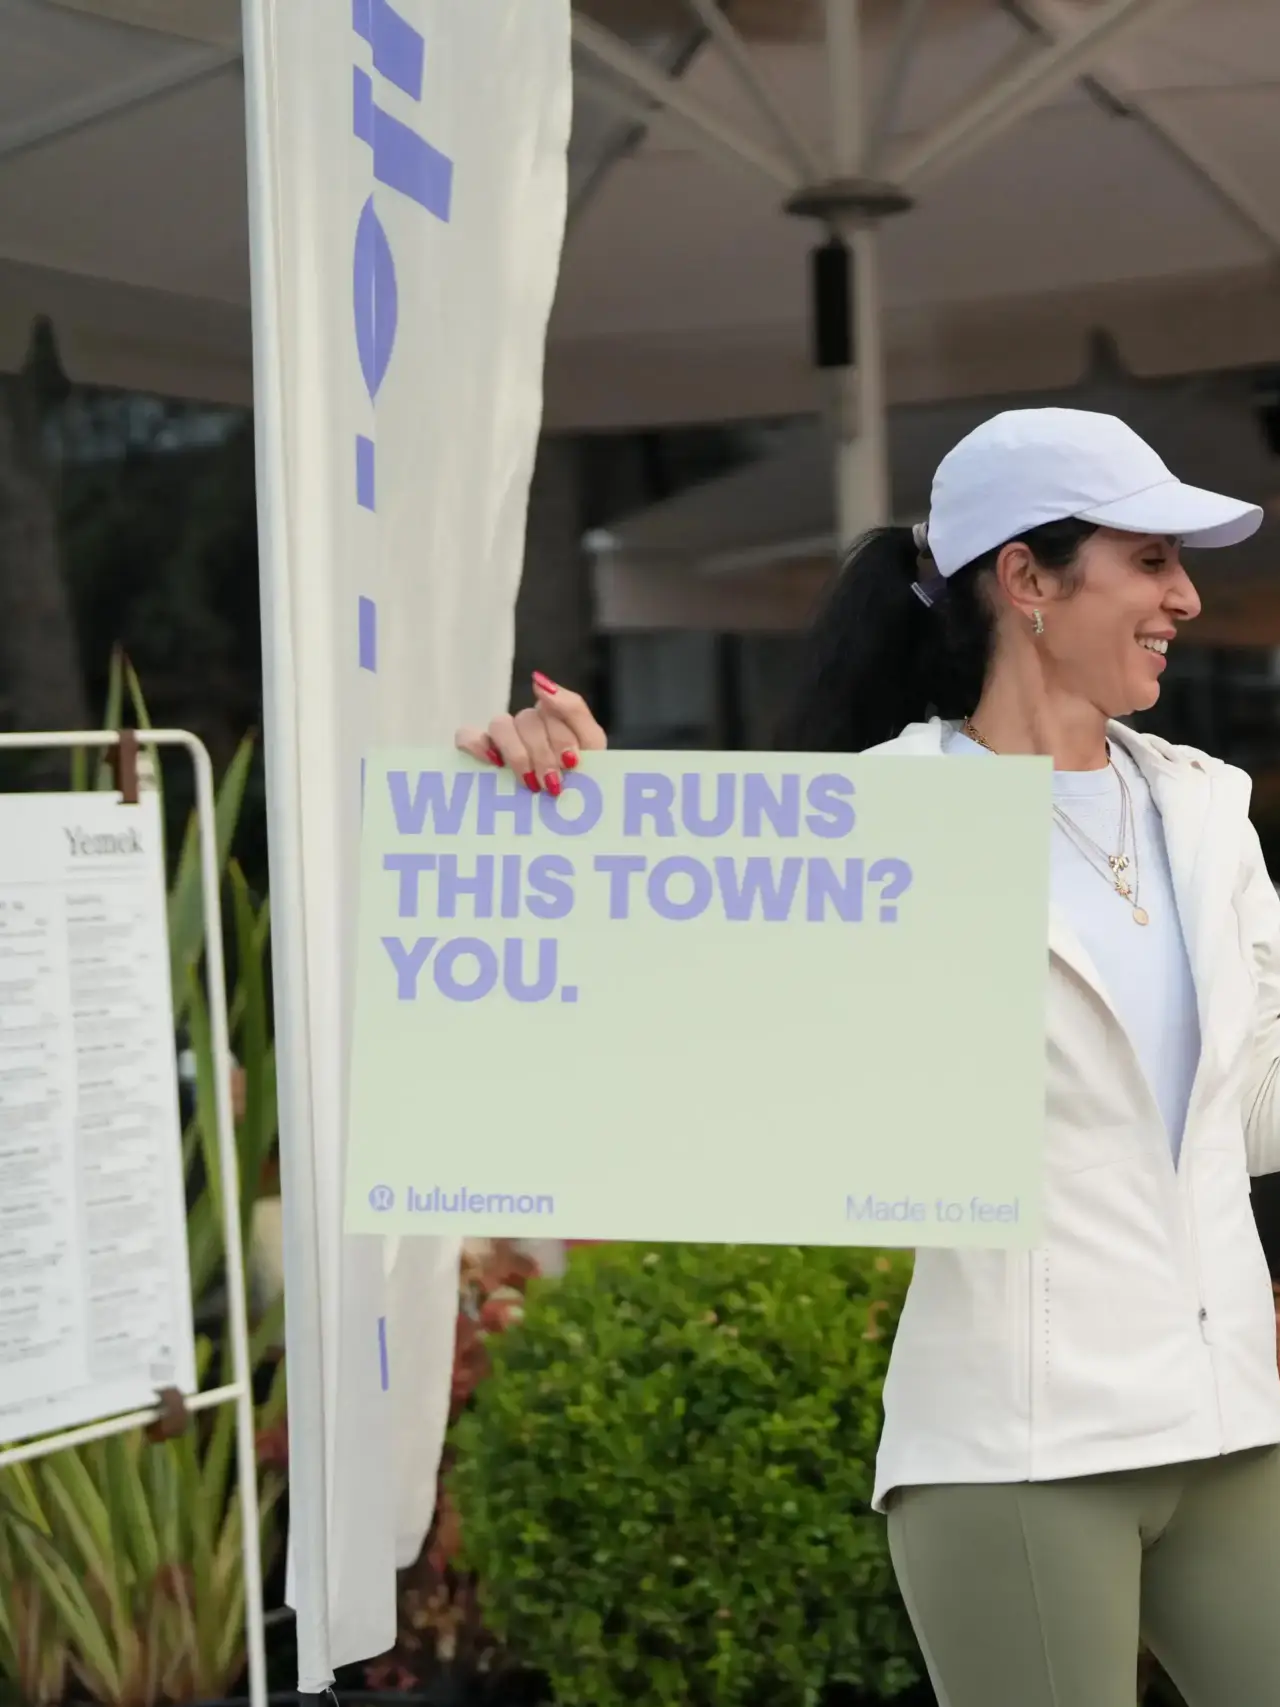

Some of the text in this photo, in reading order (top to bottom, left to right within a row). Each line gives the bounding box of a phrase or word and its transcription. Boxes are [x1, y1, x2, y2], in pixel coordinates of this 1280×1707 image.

[386, 770, 856, 839] WHO RUNS
[382, 853, 913, 923] THIS TOWN?
[380, 936, 579, 1003] YOU.
[406, 1184, 555, 1215] lululemon
[845, 1194, 1020, 1224] Made to feel
